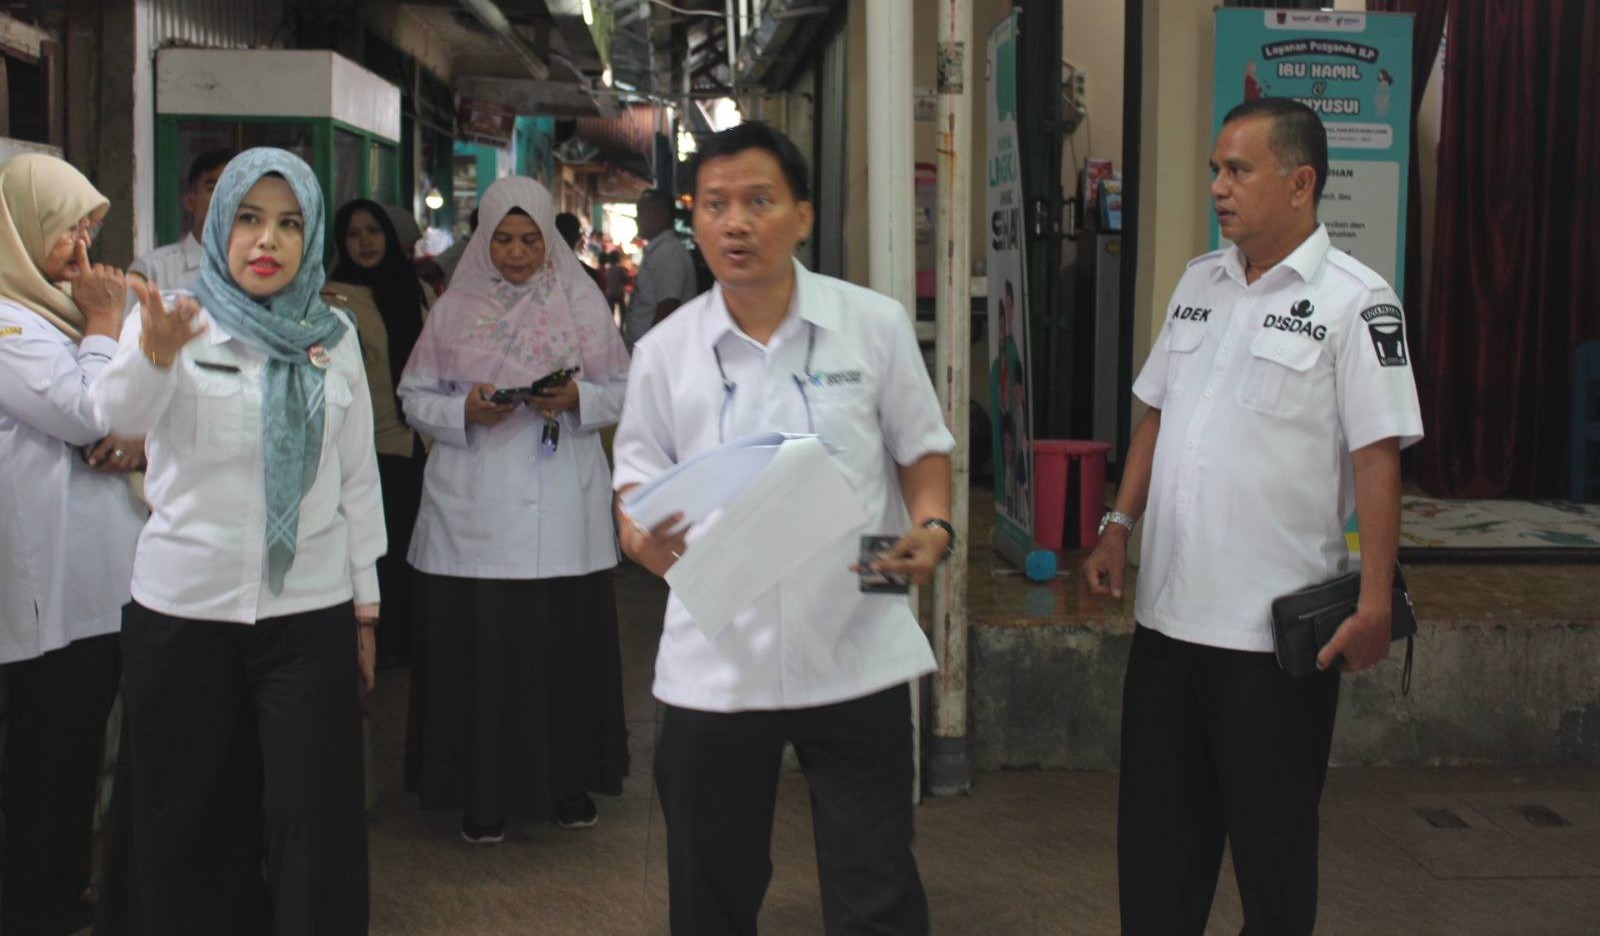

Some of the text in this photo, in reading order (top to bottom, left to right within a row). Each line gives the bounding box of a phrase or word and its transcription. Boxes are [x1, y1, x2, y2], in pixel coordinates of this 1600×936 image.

[1265, 43, 1307, 57] Layanan
[1278, 62, 1361, 80] IBU HAMIL
[1292, 97, 1360, 114] NYUSUI
